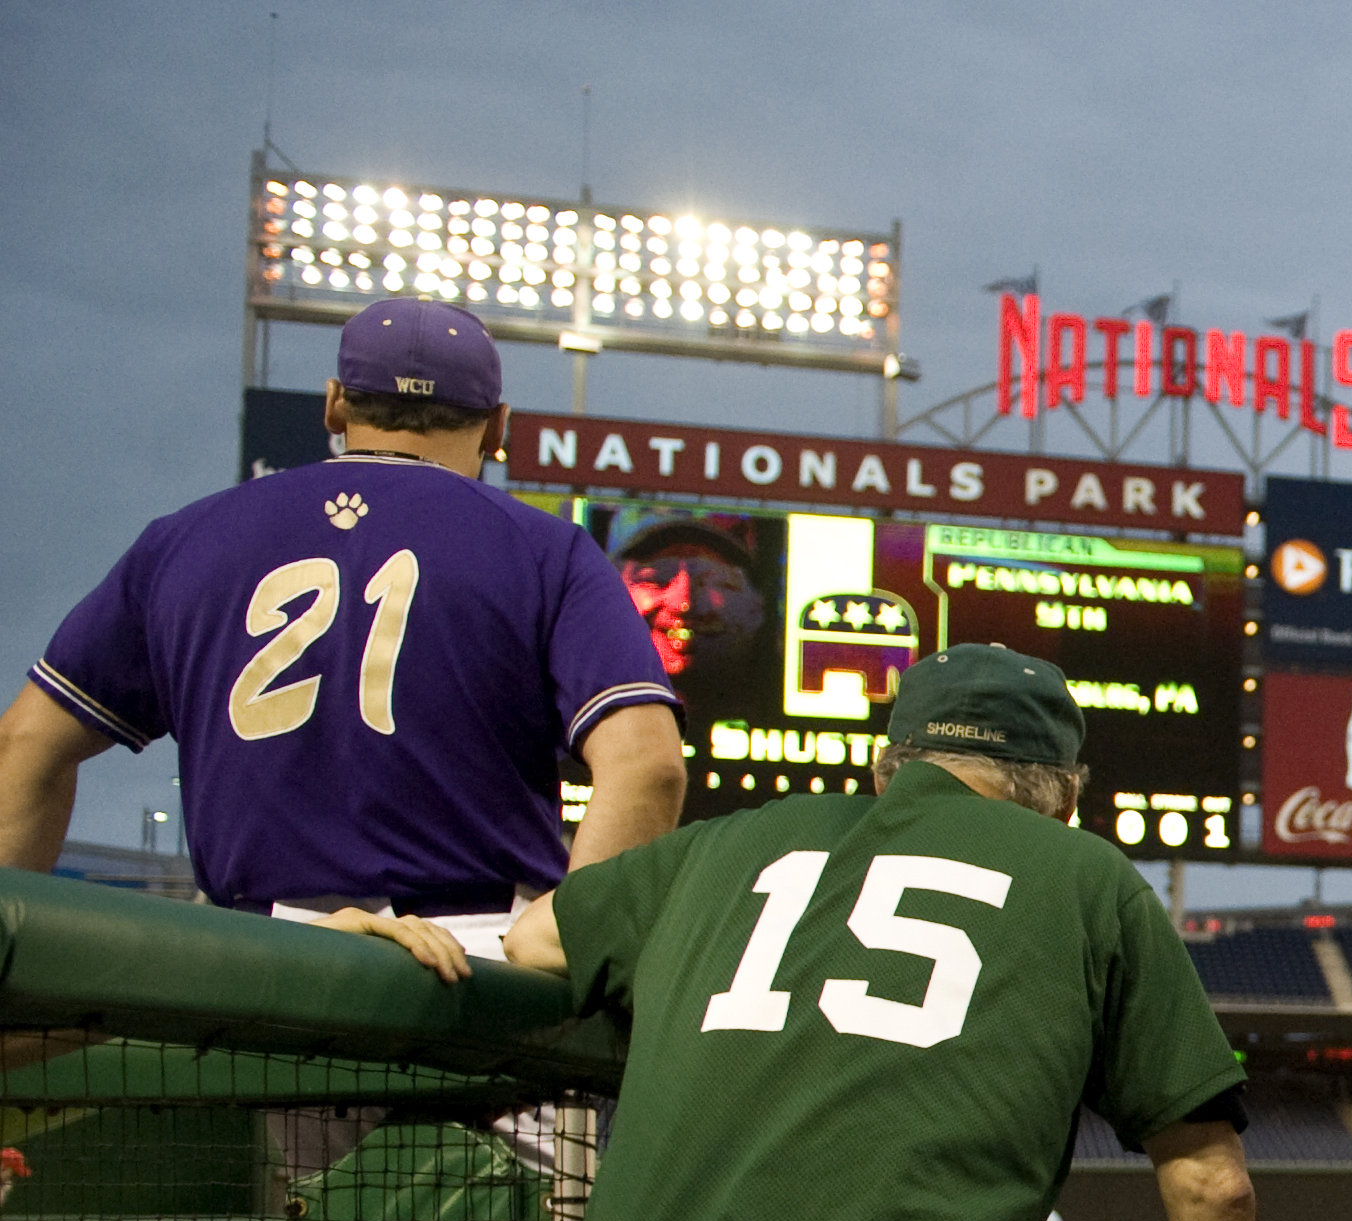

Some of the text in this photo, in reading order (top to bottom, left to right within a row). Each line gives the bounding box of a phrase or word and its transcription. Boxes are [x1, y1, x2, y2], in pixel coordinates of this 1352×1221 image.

[394, 376, 436, 395] WCU
[538, 427, 1208, 520] NATIONALS PARK
[947, 561, 1194, 606] PENNSYLVANIA
[228, 548, 421, 742] 21
[926, 721, 1007, 743] SHORELINE
[1116, 809, 1231, 848] 0 0 1
[700, 850, 1013, 1049] 15
